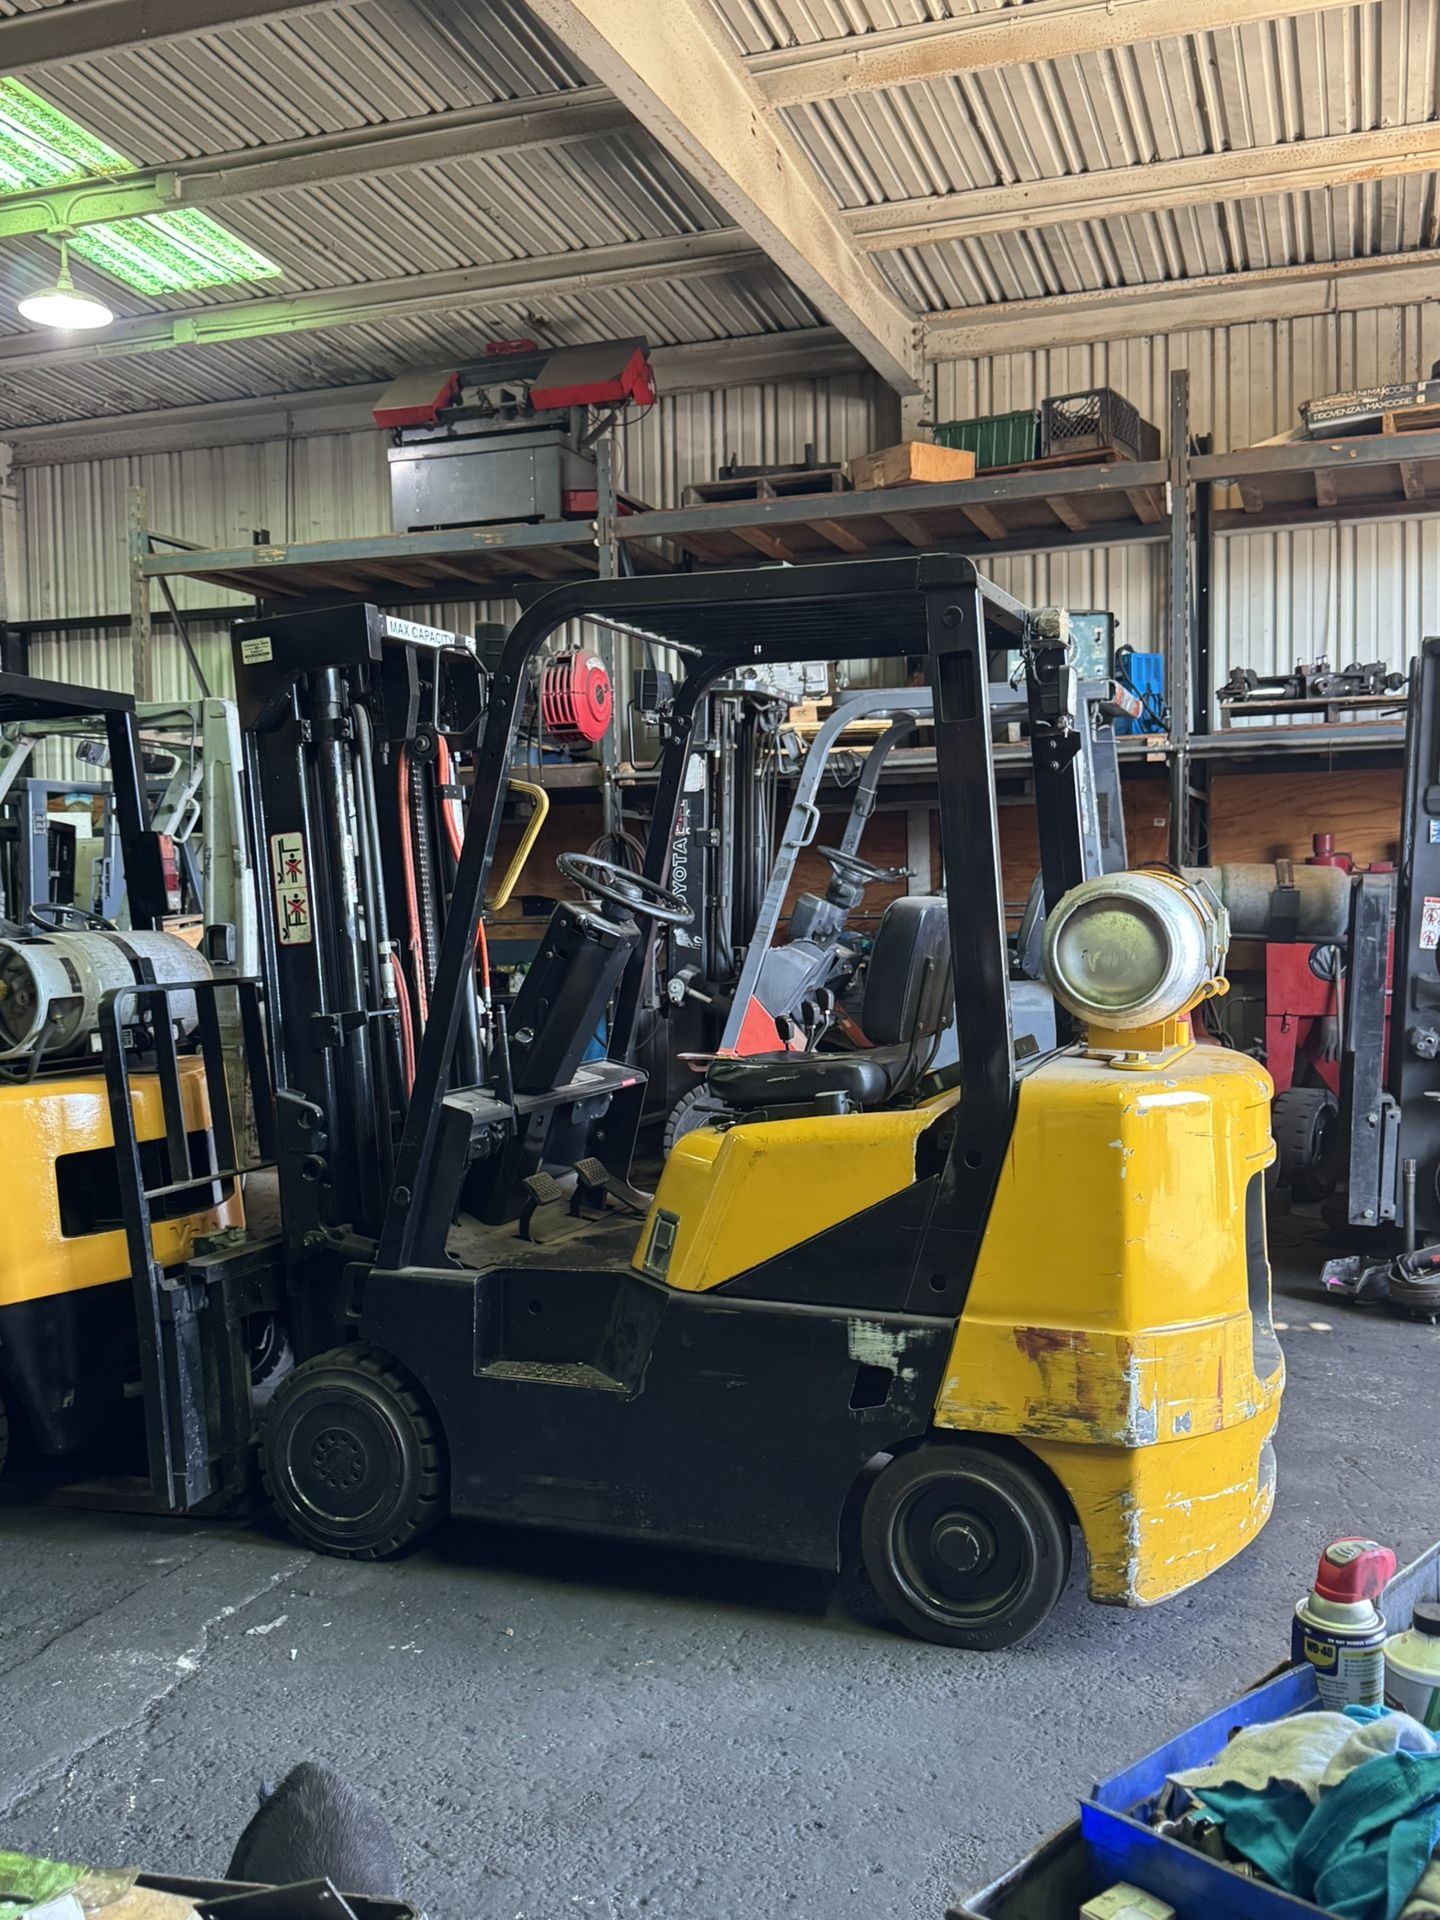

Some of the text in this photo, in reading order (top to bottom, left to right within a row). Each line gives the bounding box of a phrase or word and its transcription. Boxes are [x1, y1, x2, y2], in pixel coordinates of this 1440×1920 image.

[1313, 397, 1413, 420] PROVENZA MAXCORE
[389, 621, 454, 645] MAX CAPACITY
[672, 837, 688, 904] YOTA
[1307, 1641, 1333, 1658] WD-40
